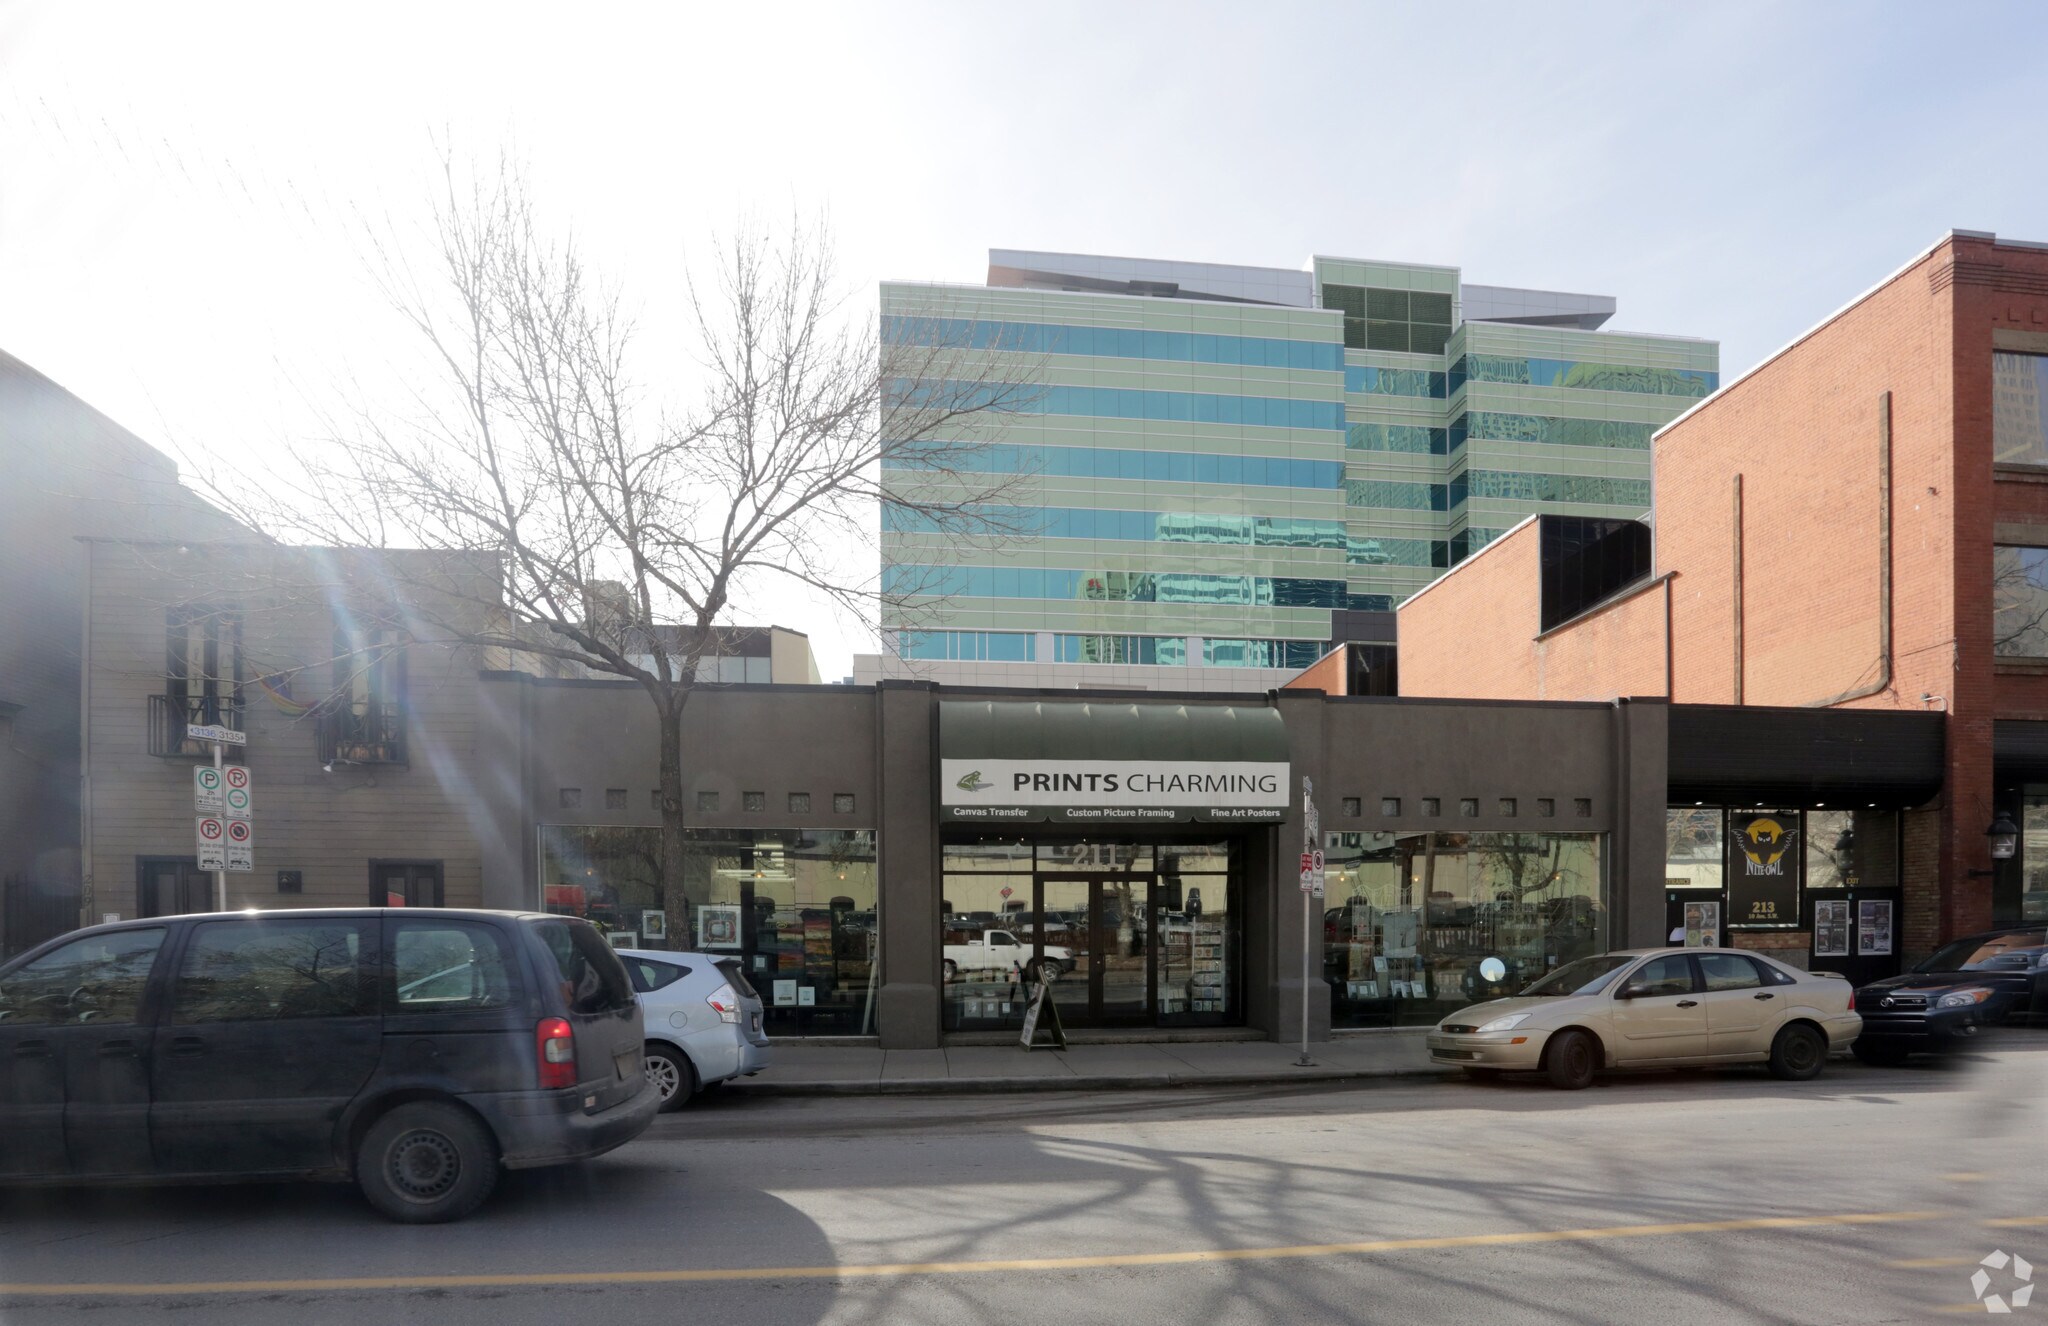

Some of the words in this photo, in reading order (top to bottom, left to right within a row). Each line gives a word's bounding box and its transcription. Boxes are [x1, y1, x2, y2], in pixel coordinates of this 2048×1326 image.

[194, 727, 217, 738] 3136
[219, 730, 241, 742] 3135
[1013, 773, 1119, 792] PRINTS
[1126, 774, 1277, 793] CHARMING
[953, 808, 987, 817] Canvas
[989, 808, 1029, 817] Transfer
[1066, 809, 1102, 817] Custom
[1104, 809, 1136, 817] Picture
[1138, 809, 1175, 819] Framing
[1211, 809, 1229, 817] Fine
[1231, 809, 1246, 817] Art
[1247, 809, 1281, 818] Posters
[1073, 844, 1116, 867] 211
[1846, 877, 1859, 885] EXIT
[1752, 901, 1776, 913] 213
